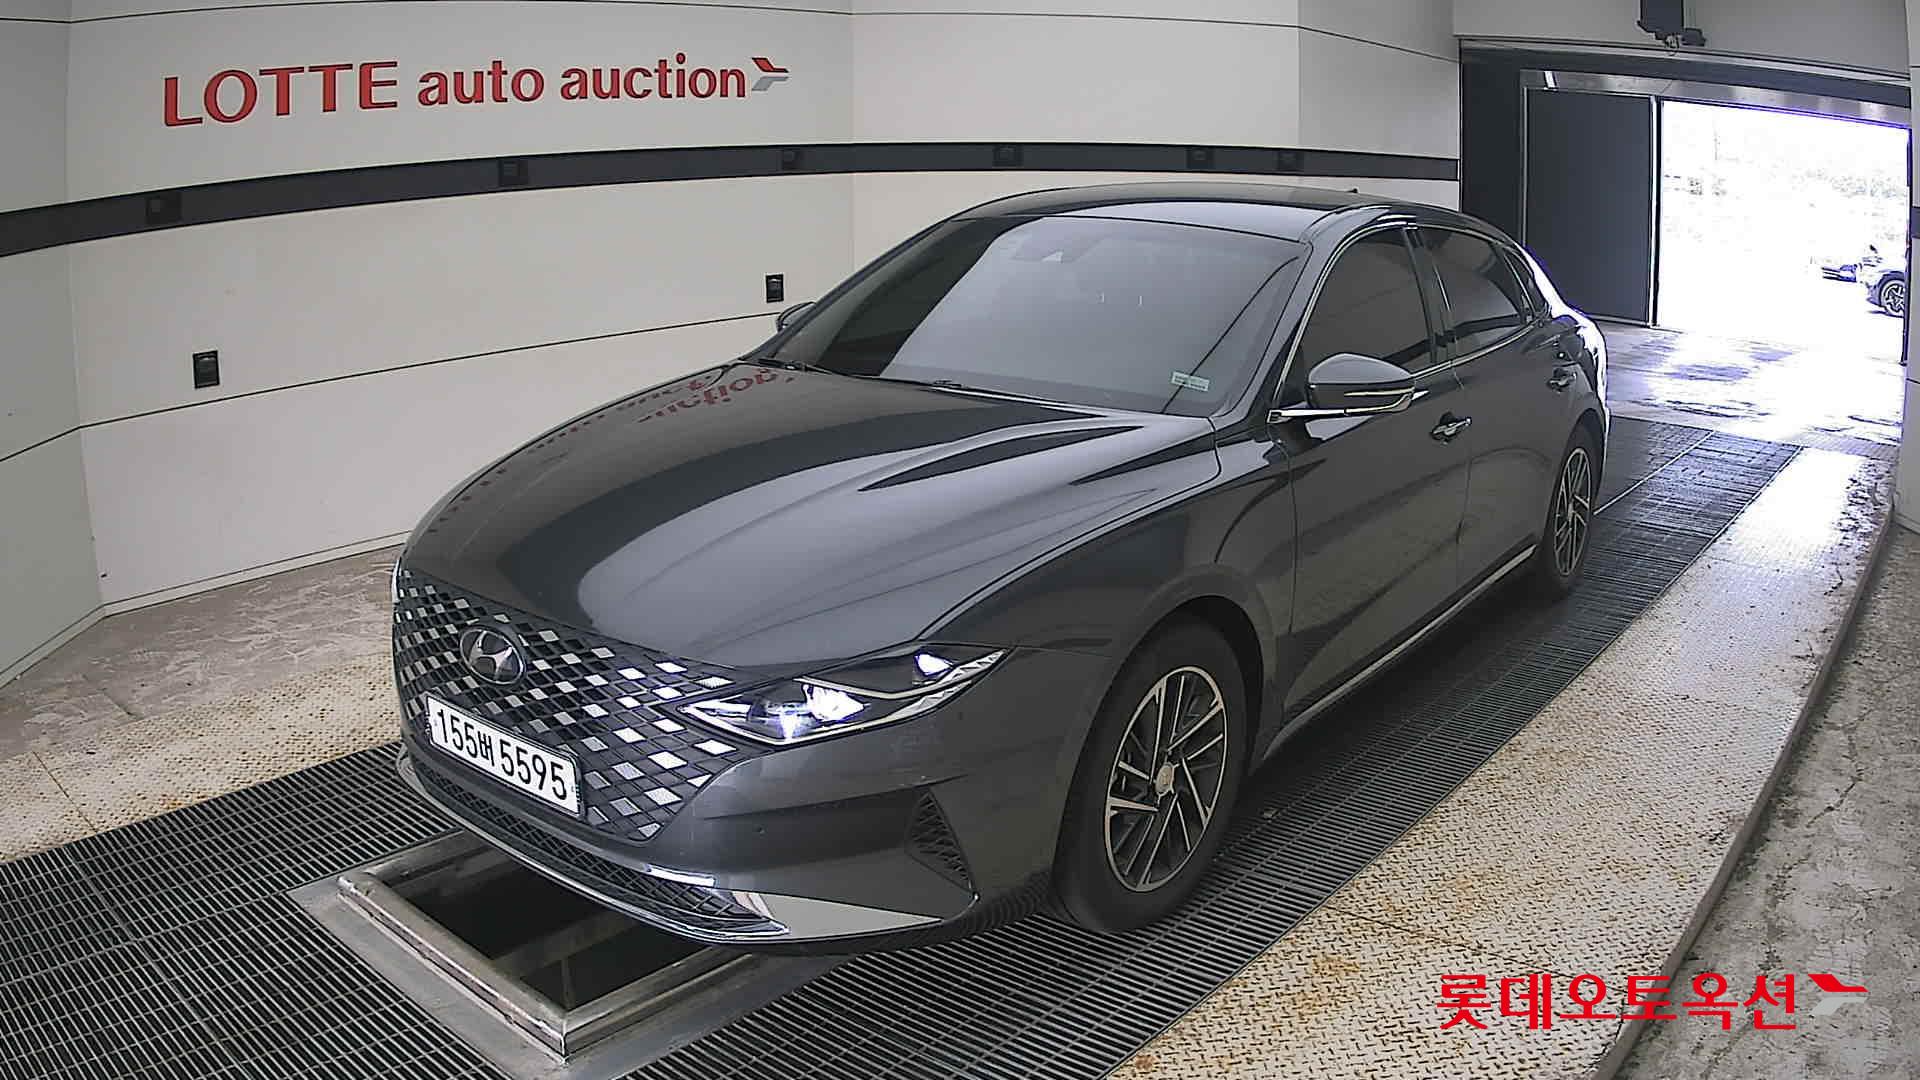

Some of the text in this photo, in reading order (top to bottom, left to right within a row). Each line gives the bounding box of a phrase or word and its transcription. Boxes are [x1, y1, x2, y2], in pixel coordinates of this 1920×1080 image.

[163, 52, 747, 127] LOTTE auto auction
[438, 708, 567, 801] 155버 5595
